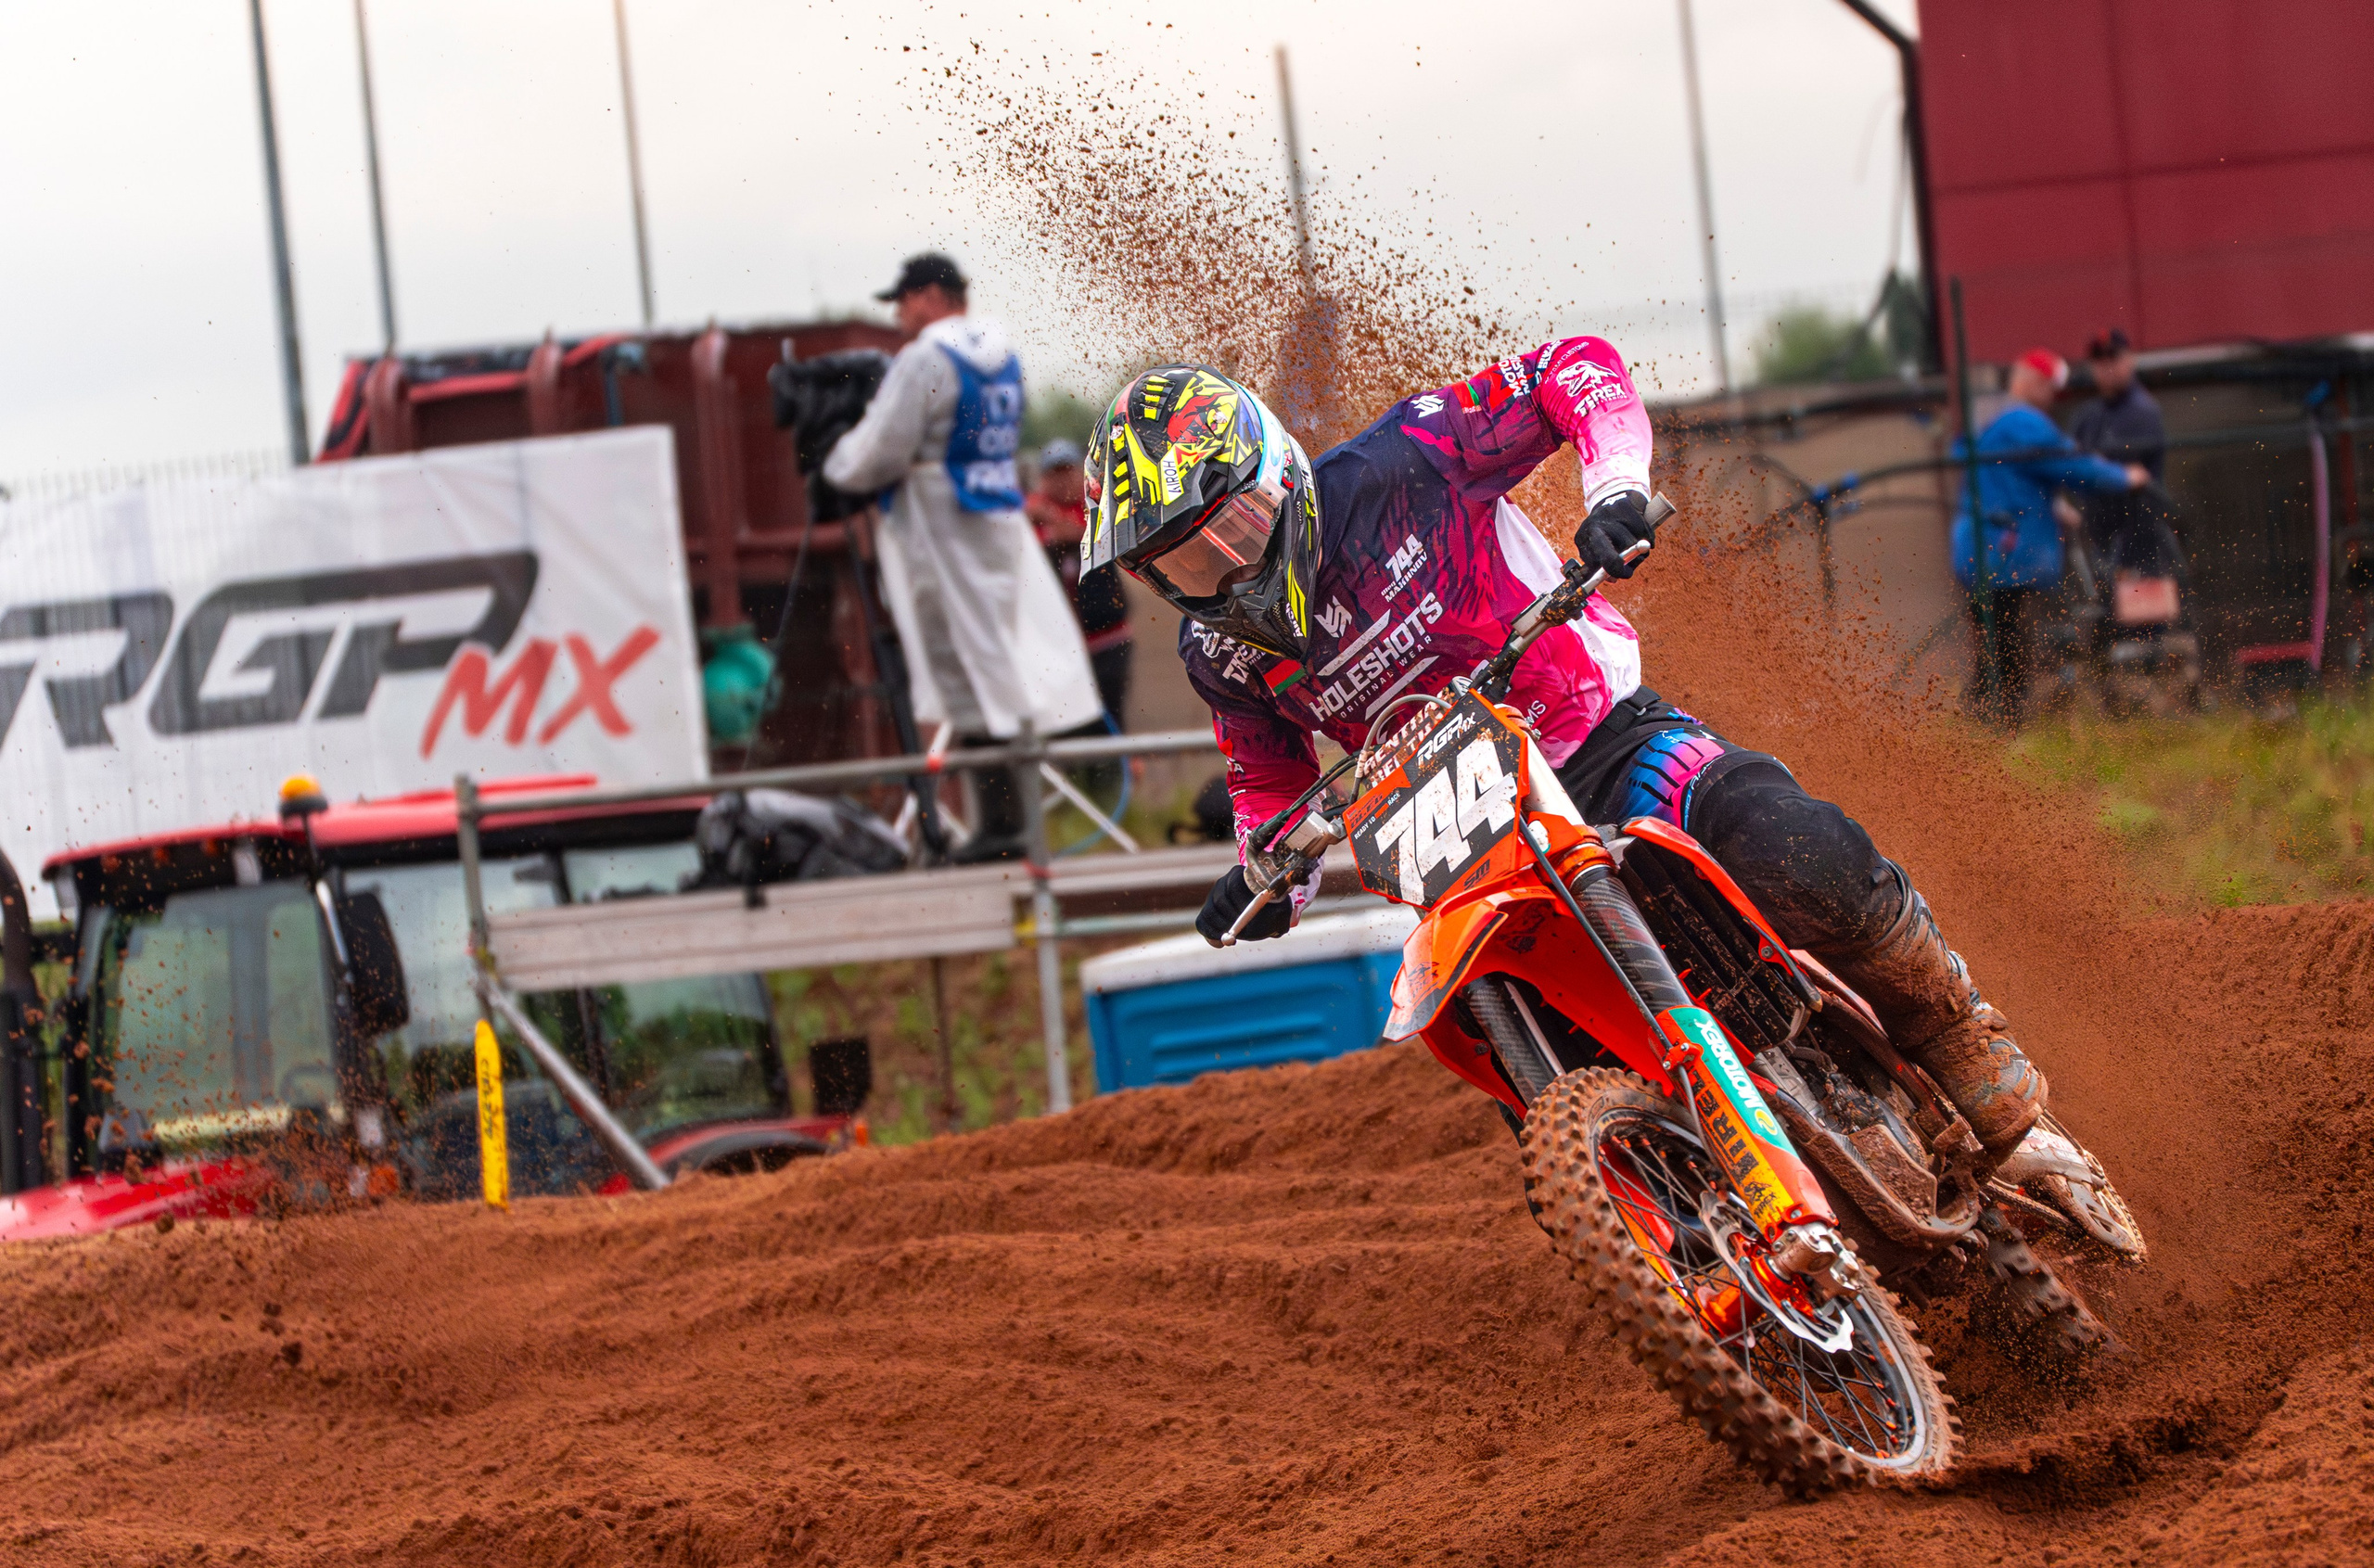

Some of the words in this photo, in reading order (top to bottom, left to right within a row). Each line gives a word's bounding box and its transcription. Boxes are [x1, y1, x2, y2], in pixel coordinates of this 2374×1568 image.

[1509, 354, 1531, 396] MAFI
[1562, 340, 1589, 362] CUSTOMS
[1498, 359, 1524, 399] MOTO
[1162, 460, 1182, 493] AIROH
[1385, 533, 1424, 583] 744
[0, 551, 540, 757] RGP
[419, 623, 661, 760] MX
[1308, 592, 1444, 722] HOLESHOTS
[1341, 670, 1394, 719] ORIGINAL
[1398, 635, 1433, 668] WEAR
[1416, 712, 1463, 771] RGP
[1354, 822, 1370, 840] READY
[1386, 792, 1401, 807] RACE
[1374, 728, 1519, 906] 744
[1693, 1017, 1763, 1110] MOTOREX
